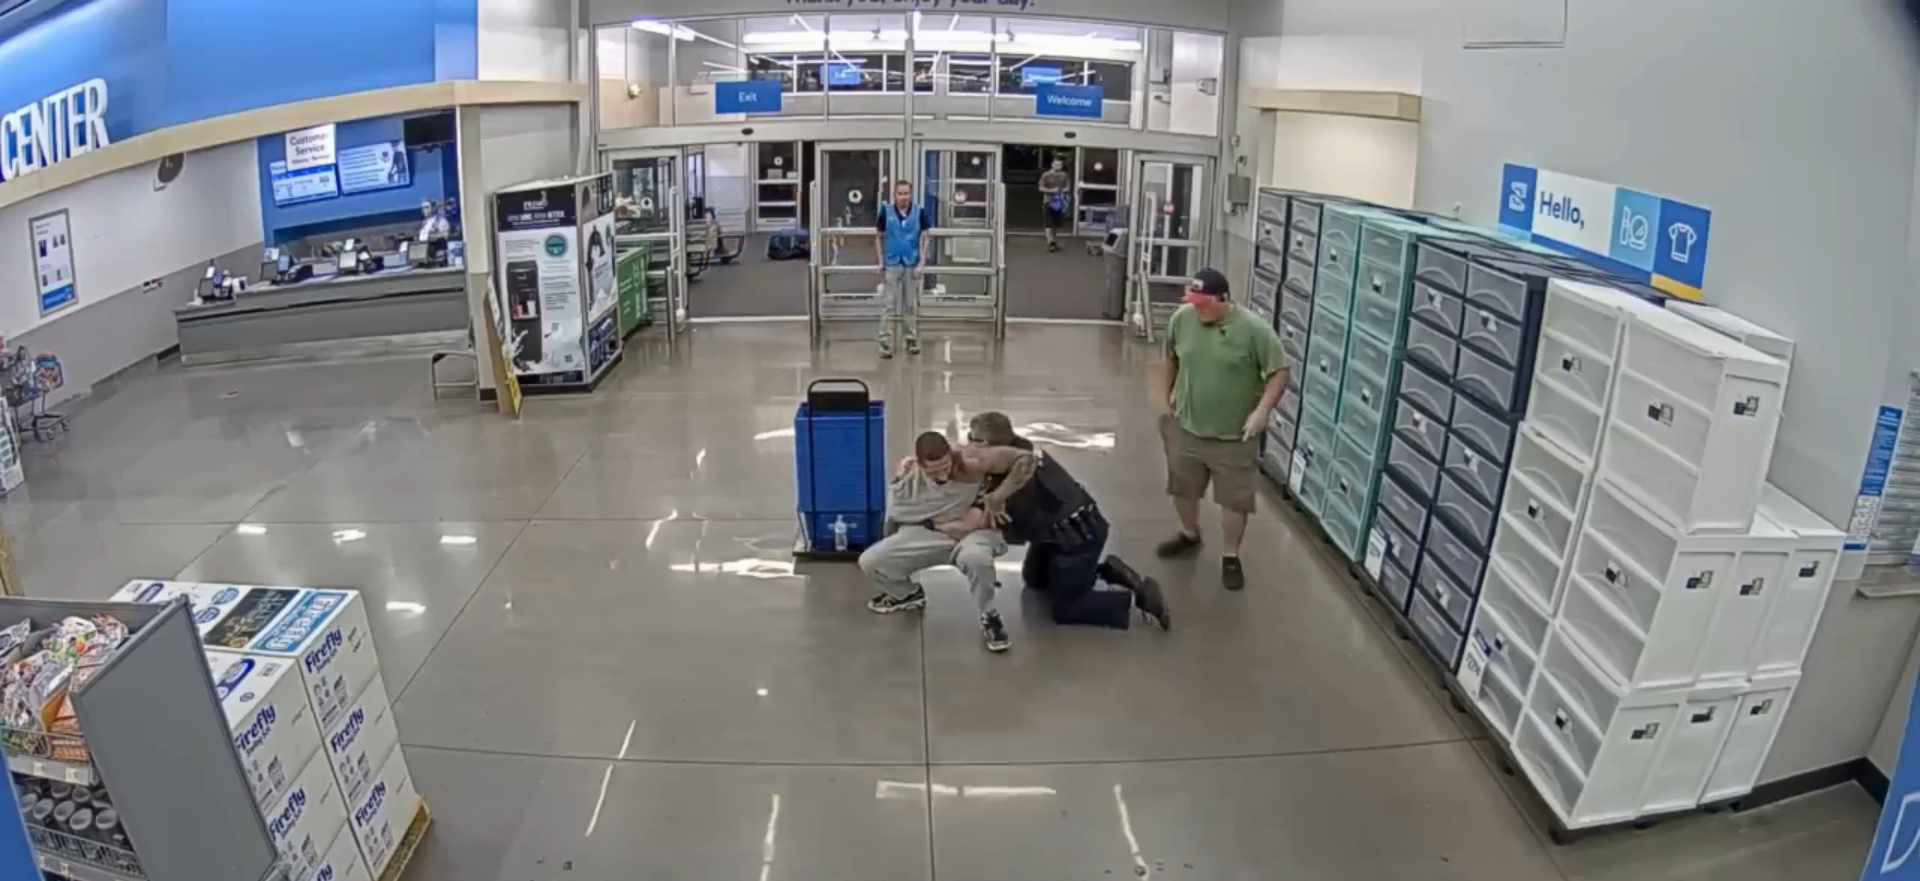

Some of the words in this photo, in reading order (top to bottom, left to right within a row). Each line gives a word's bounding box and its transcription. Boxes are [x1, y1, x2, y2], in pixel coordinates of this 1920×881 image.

[738, 91, 758, 103] Exit
[1046, 93, 1093, 107] Welcome
[0, 77, 110, 181] CENTER
[290, 132, 329, 146] Customer
[295, 144, 325, 156] Service
[1538, 190, 1585, 230] Hello,
[304, 628, 343, 674] Firefly
[330, 707, 364, 754] Firefly
[269, 787, 306, 842] Firefly
[354, 780, 387, 829] Firefly
